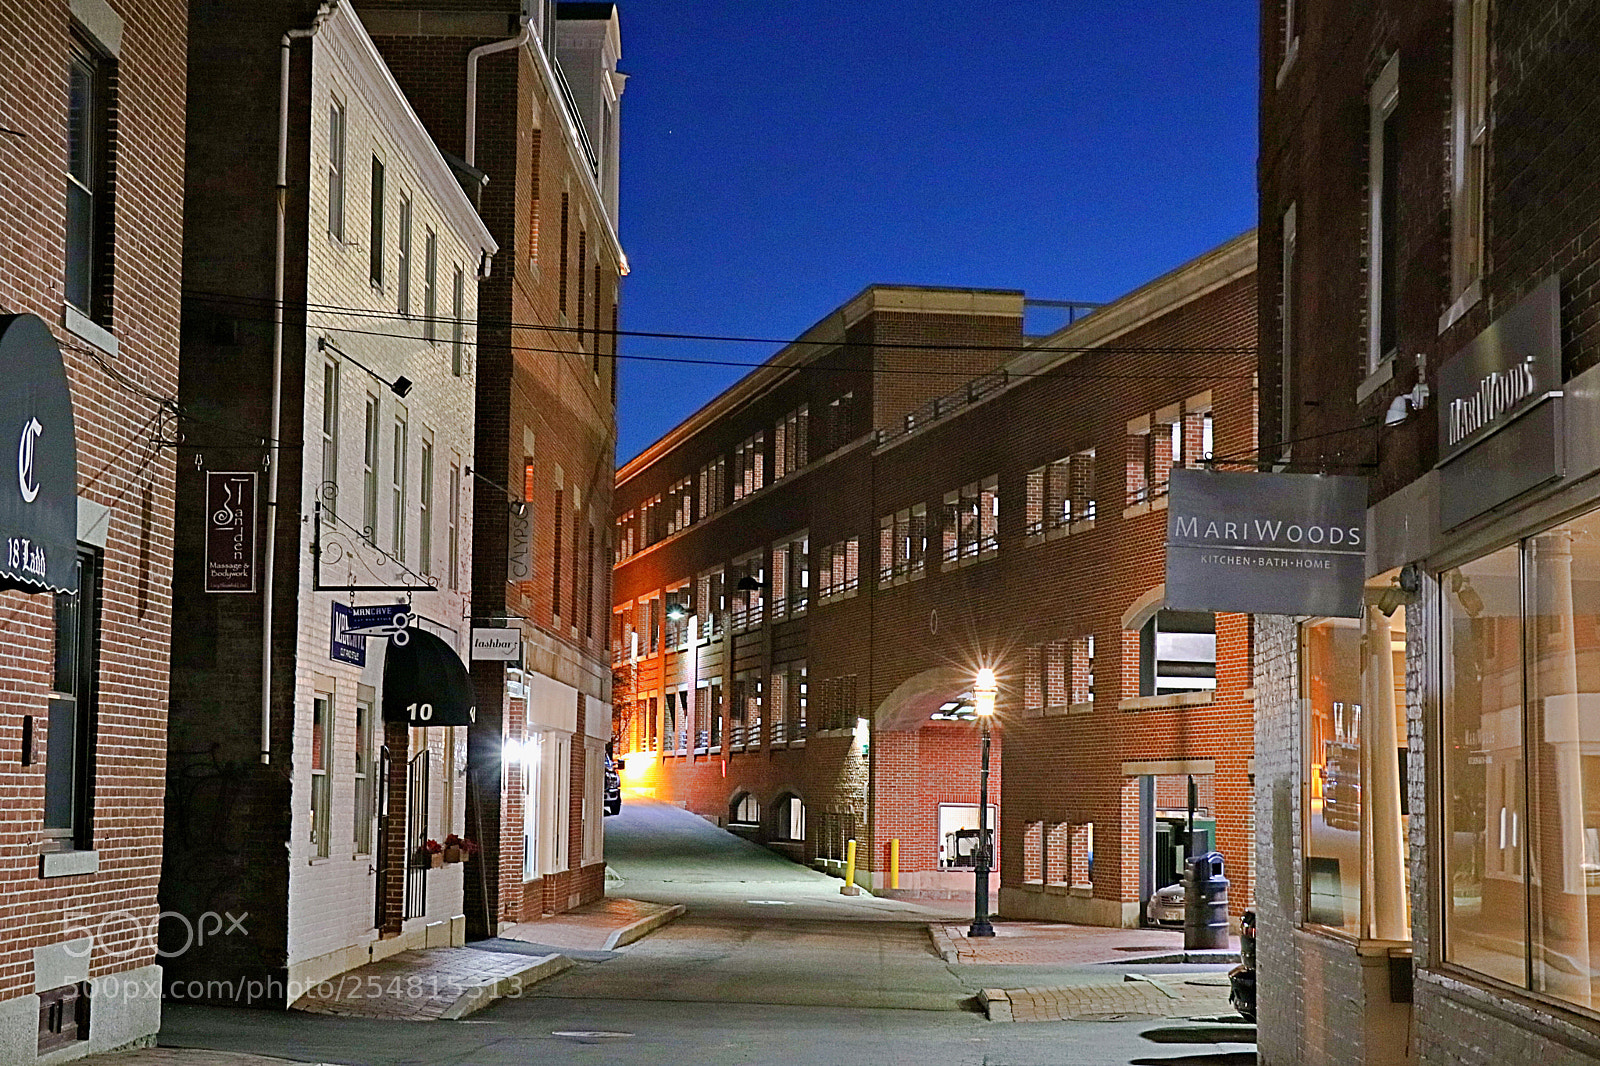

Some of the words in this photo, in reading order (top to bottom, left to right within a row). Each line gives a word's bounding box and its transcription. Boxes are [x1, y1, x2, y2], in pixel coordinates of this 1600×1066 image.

[8, 537, 20, 569] 18
[209, 561, 242, 571] Massage
[211, 569, 248, 579] Bodywork
[406, 703, 433, 721] 10
